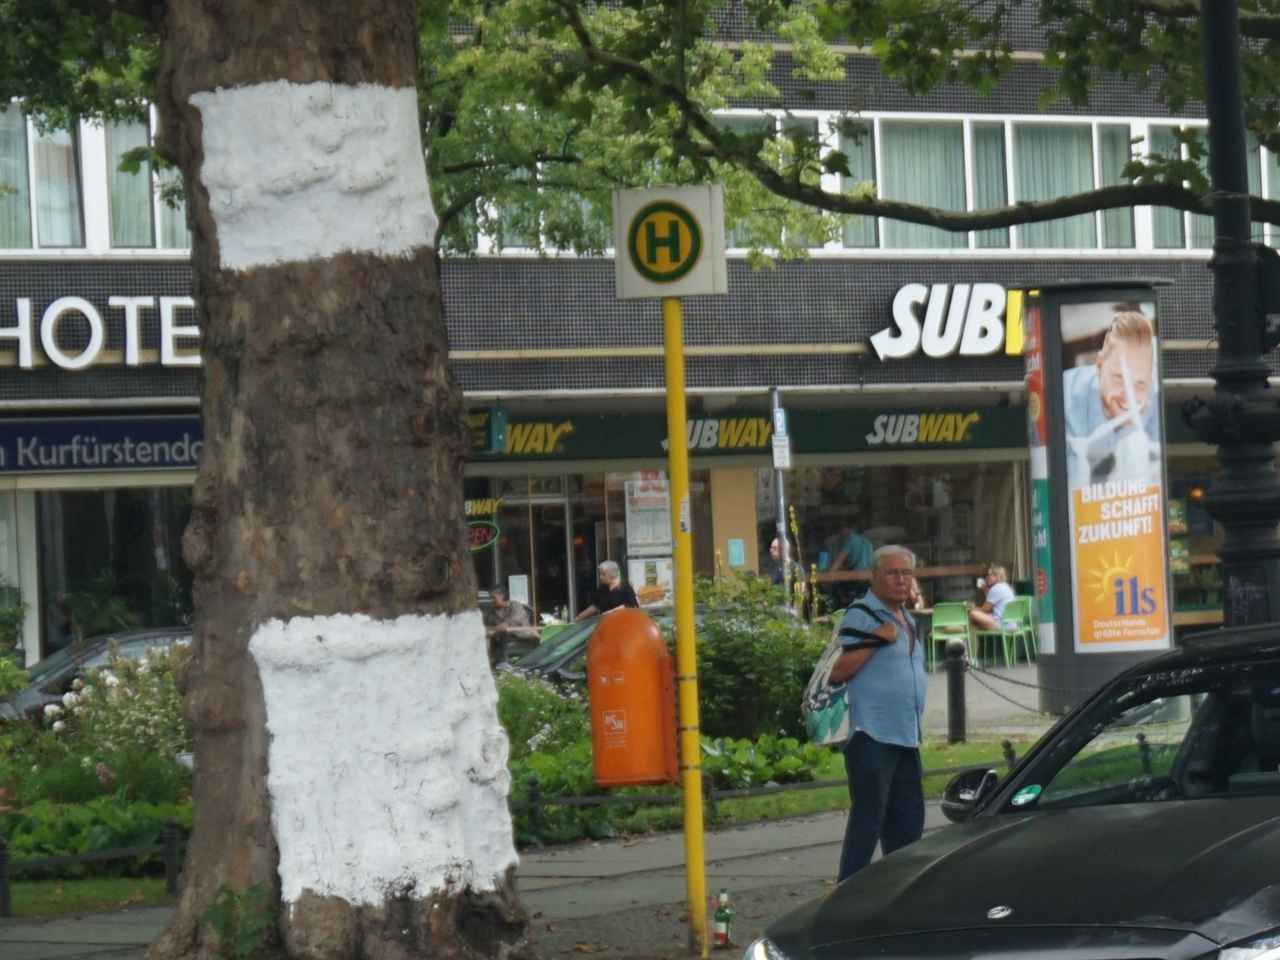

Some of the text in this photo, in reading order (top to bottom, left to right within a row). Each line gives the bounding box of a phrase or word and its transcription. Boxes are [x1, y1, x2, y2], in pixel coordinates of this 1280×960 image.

[645, 220, 681, 264] H
[865, 411, 979, 445] SUBWAY
[1081, 477, 1147, 503] BILDUNG
[1100, 494, 1159, 520] SCHAFFT
[1078, 515, 1153, 544] ZUKUNFT!
[1114, 575, 1156, 616] ils
[1093, 618, 1146, 628] Deutschlands
[1093, 627, 1159, 639] größte Fernschule
